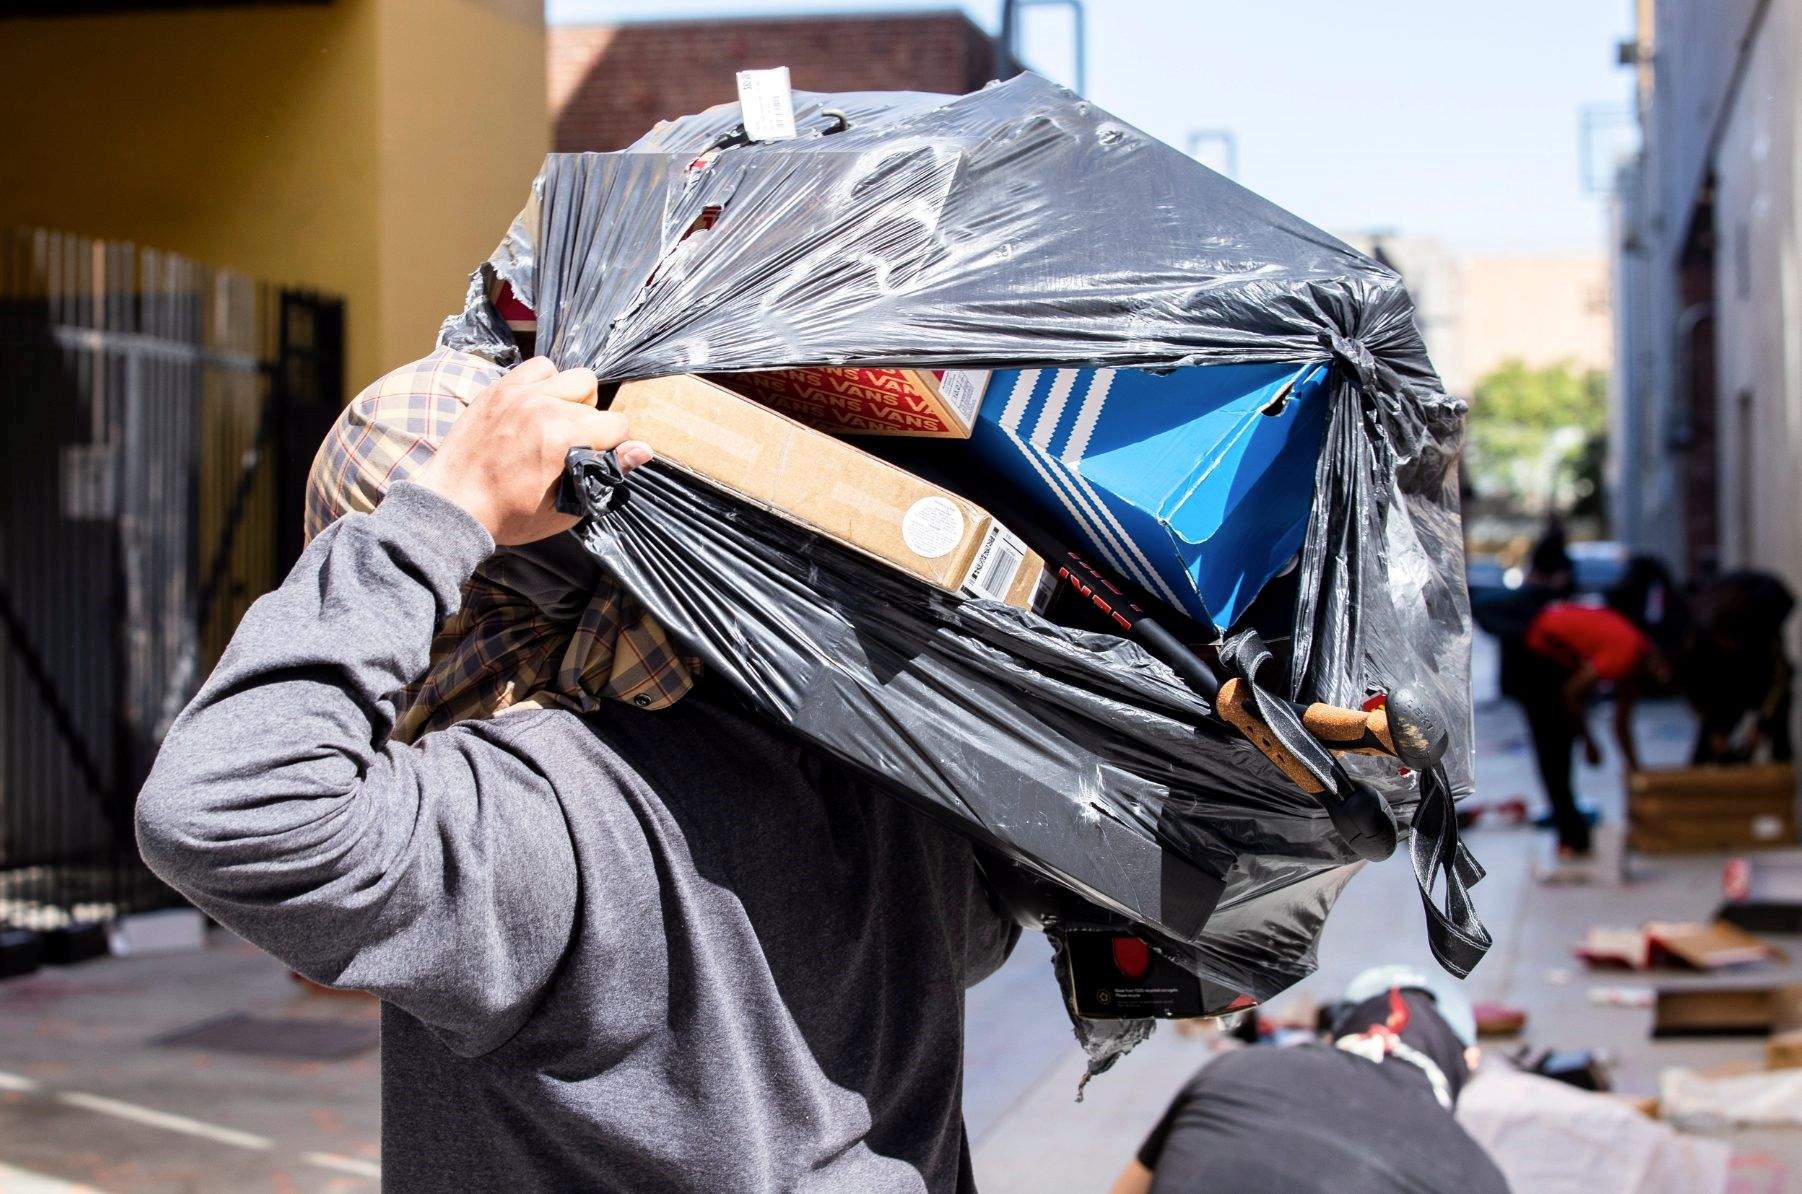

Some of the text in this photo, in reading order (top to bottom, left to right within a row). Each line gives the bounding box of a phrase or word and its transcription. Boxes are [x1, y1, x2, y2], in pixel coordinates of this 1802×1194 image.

[829, 377, 899, 406] VANS
[866, 370, 920, 396] VAN
[756, 388, 825, 417] VANS
[793, 382, 862, 412] VANS
[868, 402, 940, 431] VANS
